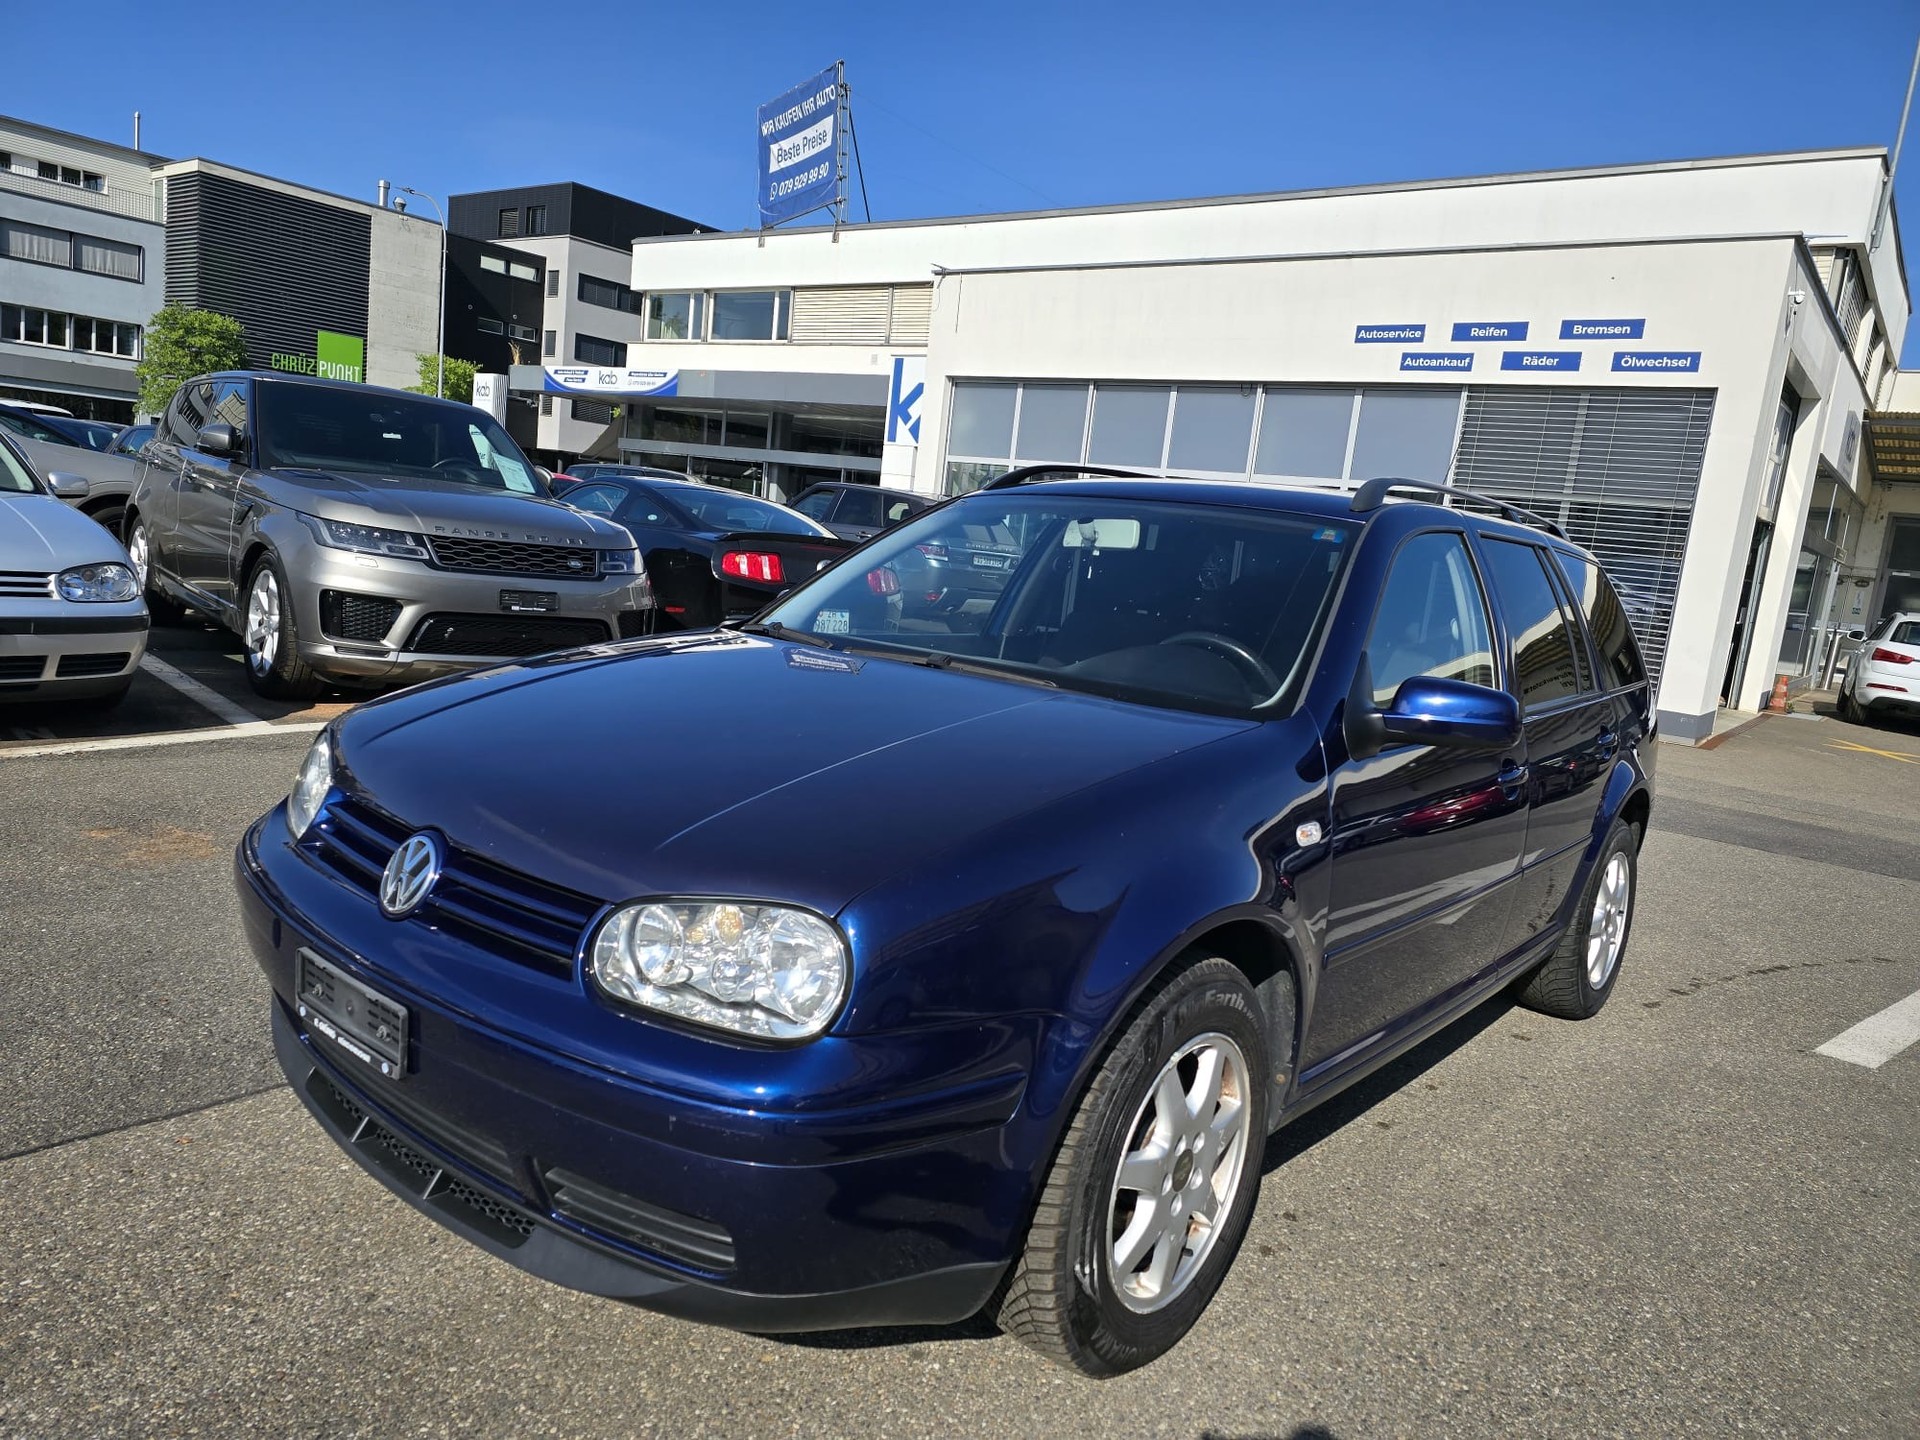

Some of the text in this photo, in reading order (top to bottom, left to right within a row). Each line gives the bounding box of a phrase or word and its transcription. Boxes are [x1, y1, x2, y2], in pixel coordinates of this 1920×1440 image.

[774, 105, 802, 129] KAUFEN
[802, 98, 816, 116] IHR
[816, 85, 836, 107] AUTO
[777, 128, 828, 163] Beste Preise
[778, 162, 829, 196] 079 929 99 90
[1358, 329, 1422, 339] Autoservice
[1470, 327, 1508, 337] Reifen
[1573, 325, 1631, 335] Bremsen
[272, 353, 360, 382] CHRÜZ PUNKT
[1404, 357, 1470, 367] Autoankauf
[1522, 355, 1559, 366] Räder
[1621, 354, 1692, 367] Ölwechsel
[599, 370, 618, 385] kab
[476, 381, 490, 397] kab
[434, 526, 589, 545] RANGE ROVER
[833, 620, 848, 632] 228
